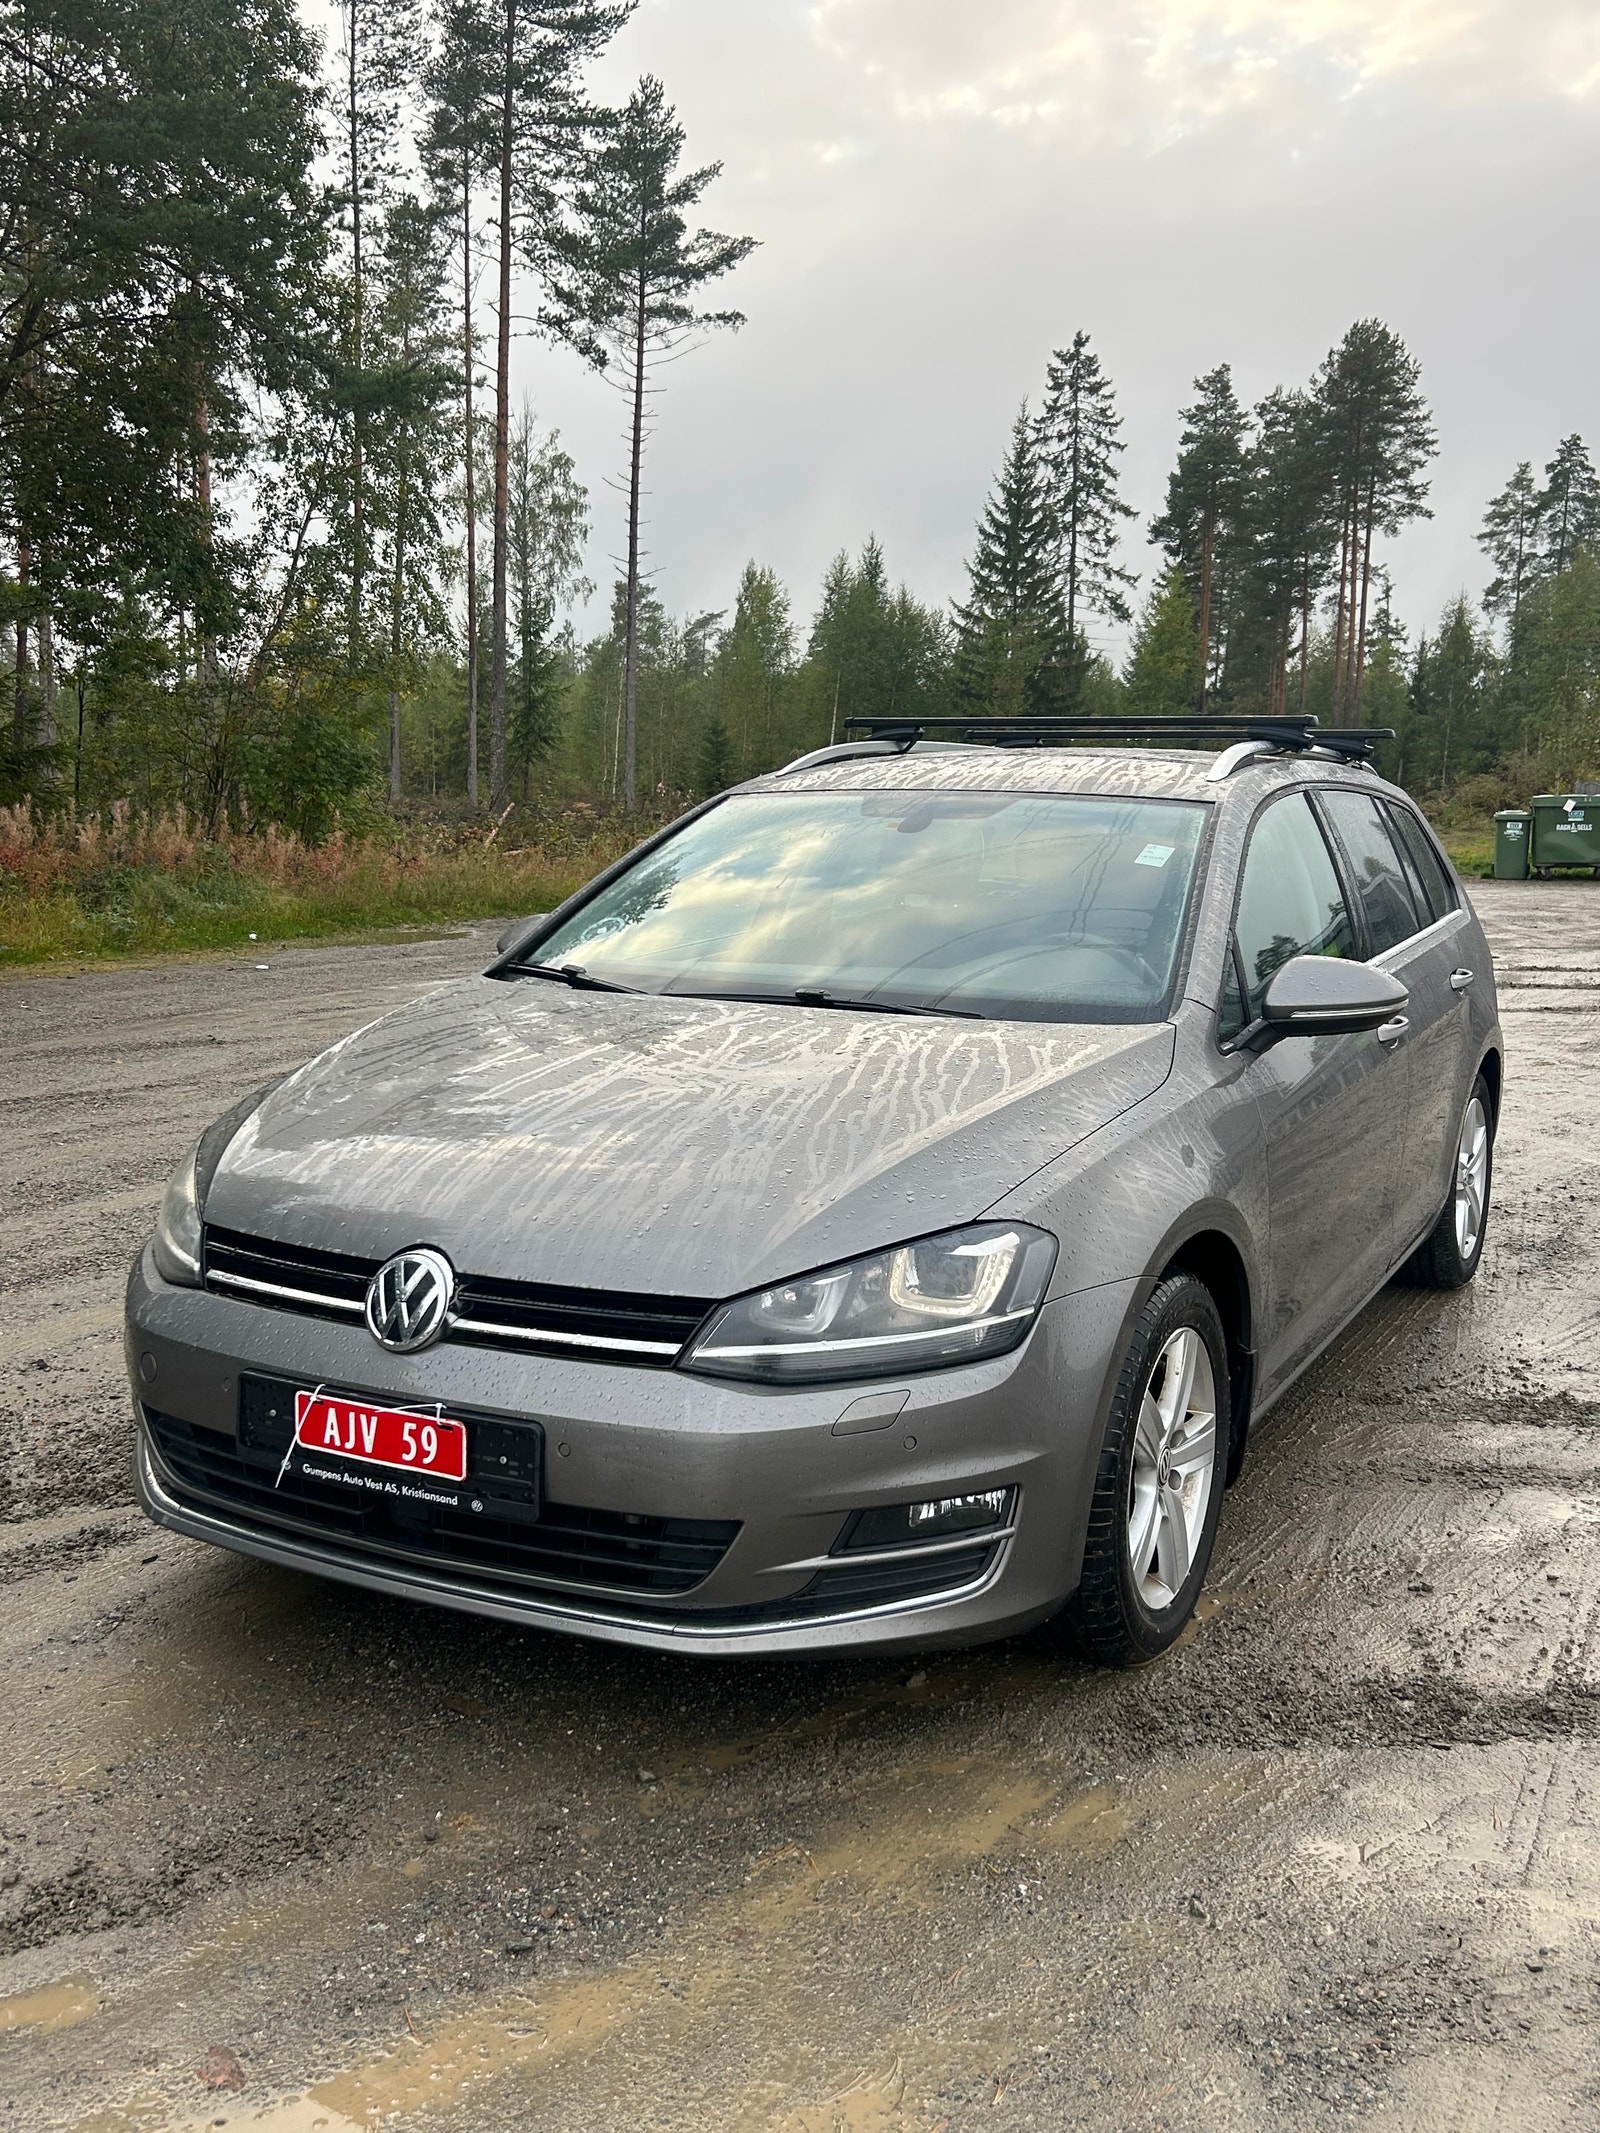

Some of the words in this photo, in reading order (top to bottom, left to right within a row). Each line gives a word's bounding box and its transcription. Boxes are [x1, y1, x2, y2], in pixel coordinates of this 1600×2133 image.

[372, 1257, 440, 1343] VW
[323, 1407, 378, 1454] AJV
[401, 1422, 438, 1465] 59
[302, 1463, 342, 1481] Gumpens
[342, 1472, 364, 1486] Auto
[364, 1477, 383, 1490] Vest
[384, 1482, 400, 1496] AS,
[401, 1485, 458, 1506] Kristiansand
